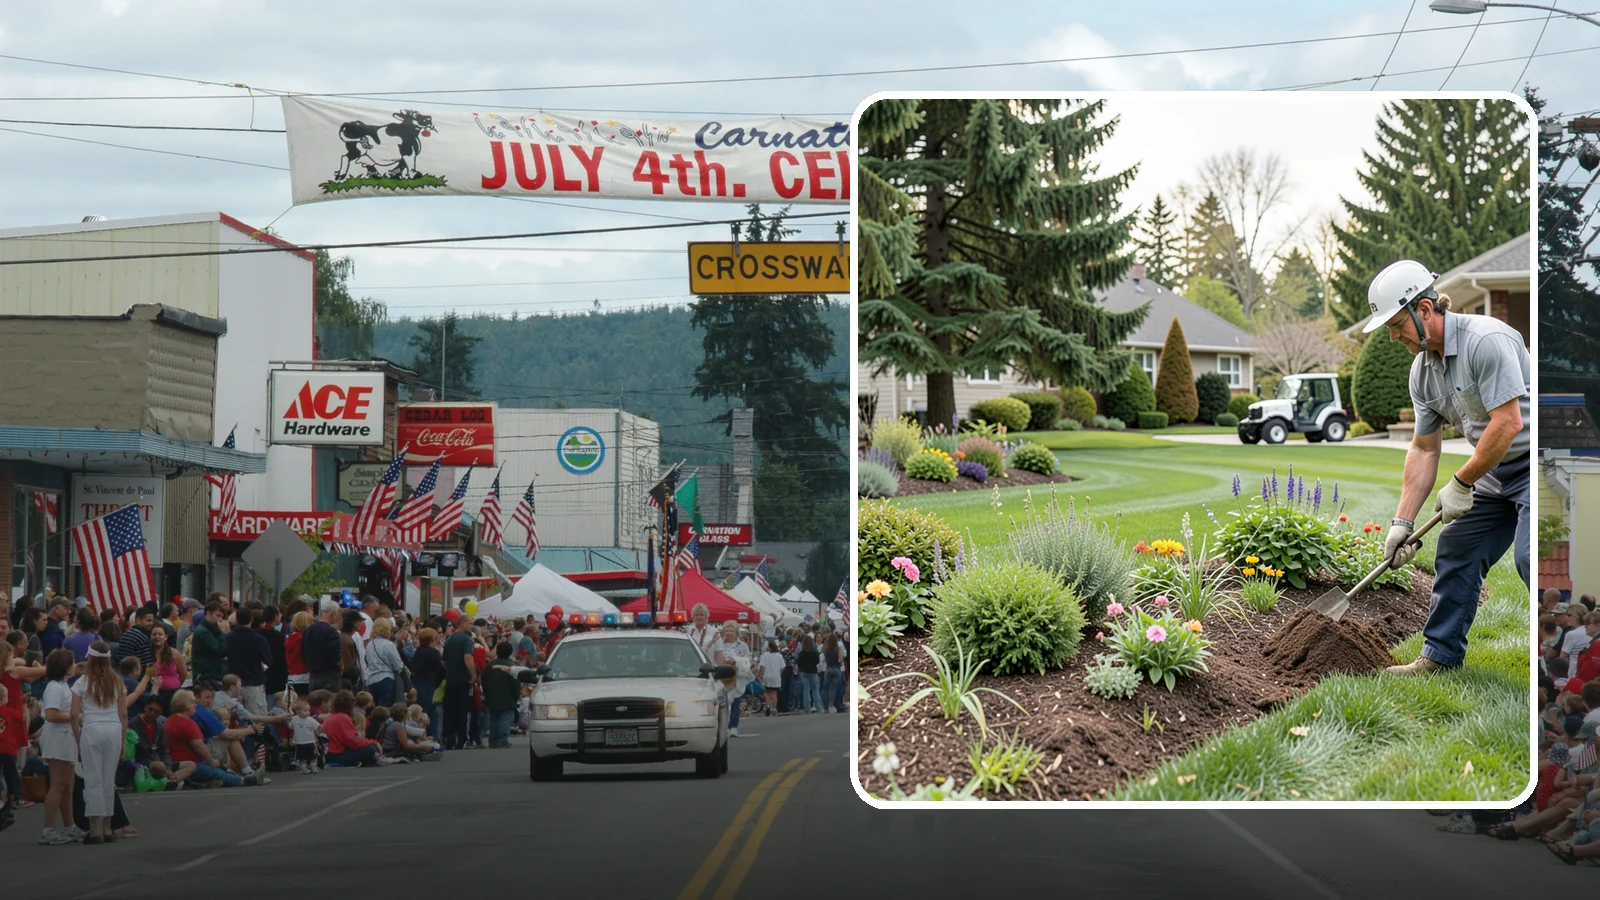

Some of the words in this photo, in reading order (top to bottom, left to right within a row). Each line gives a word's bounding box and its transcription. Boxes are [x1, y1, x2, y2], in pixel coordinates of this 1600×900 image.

[481, 141, 604, 192] JULY
[632, 150, 746, 197] 4th.
[697, 254, 850, 280] CROSSWA
[283, 380, 373, 420] ACE
[405, 409, 452, 422] CEDAR
[461, 409, 485, 422] LOG
[283, 421, 370, 436] Hardware
[417, 428, 477, 447] Coca-Cola
[353, 467, 389, 480] Simpl
[83, 484, 93, 494] St.
[95, 485, 124, 495] Vincent
[126, 486, 136, 495] de
[137, 486, 155, 495] Paul
[81, 503, 153, 522] THT
[213, 516, 330, 535] HARDARE
[688, 526, 741, 535] CRNATION
[699, 535, 730, 543] GLASS
